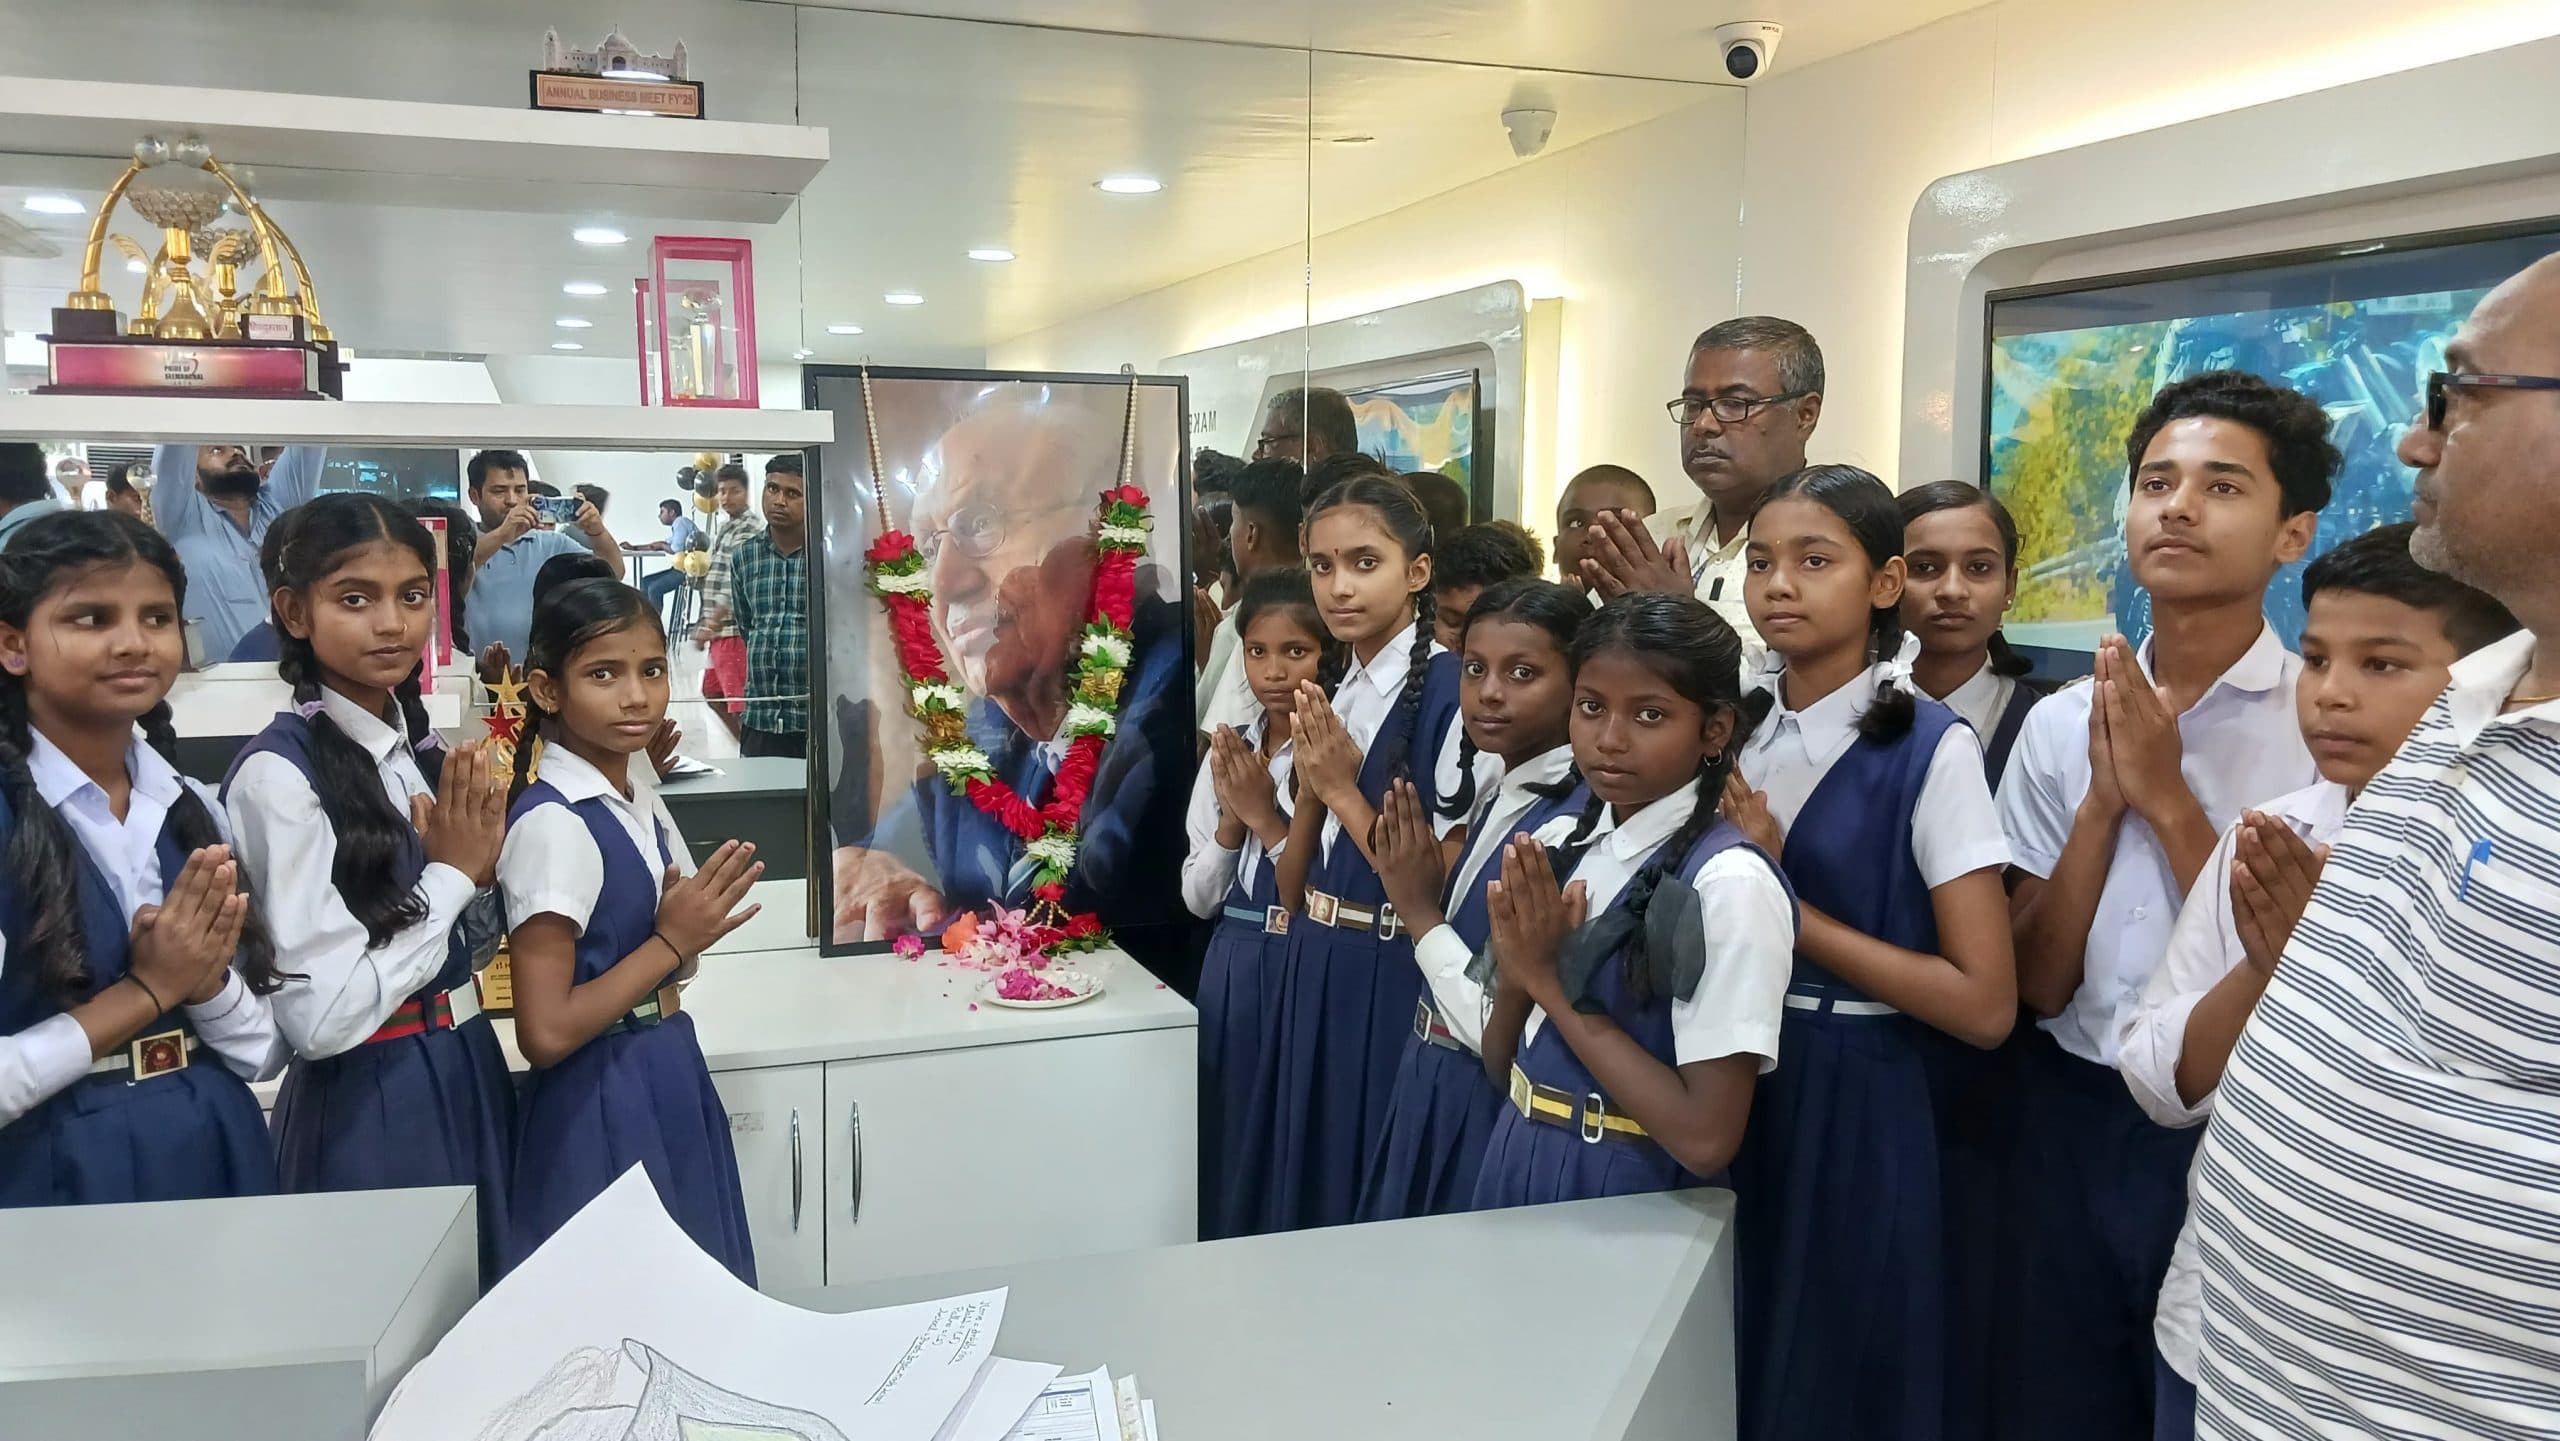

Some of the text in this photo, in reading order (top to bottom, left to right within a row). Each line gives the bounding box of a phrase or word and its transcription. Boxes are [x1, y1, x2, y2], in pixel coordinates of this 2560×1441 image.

[546, 86, 693, 105] ANNUAL BUSINESS MEET FY'25
